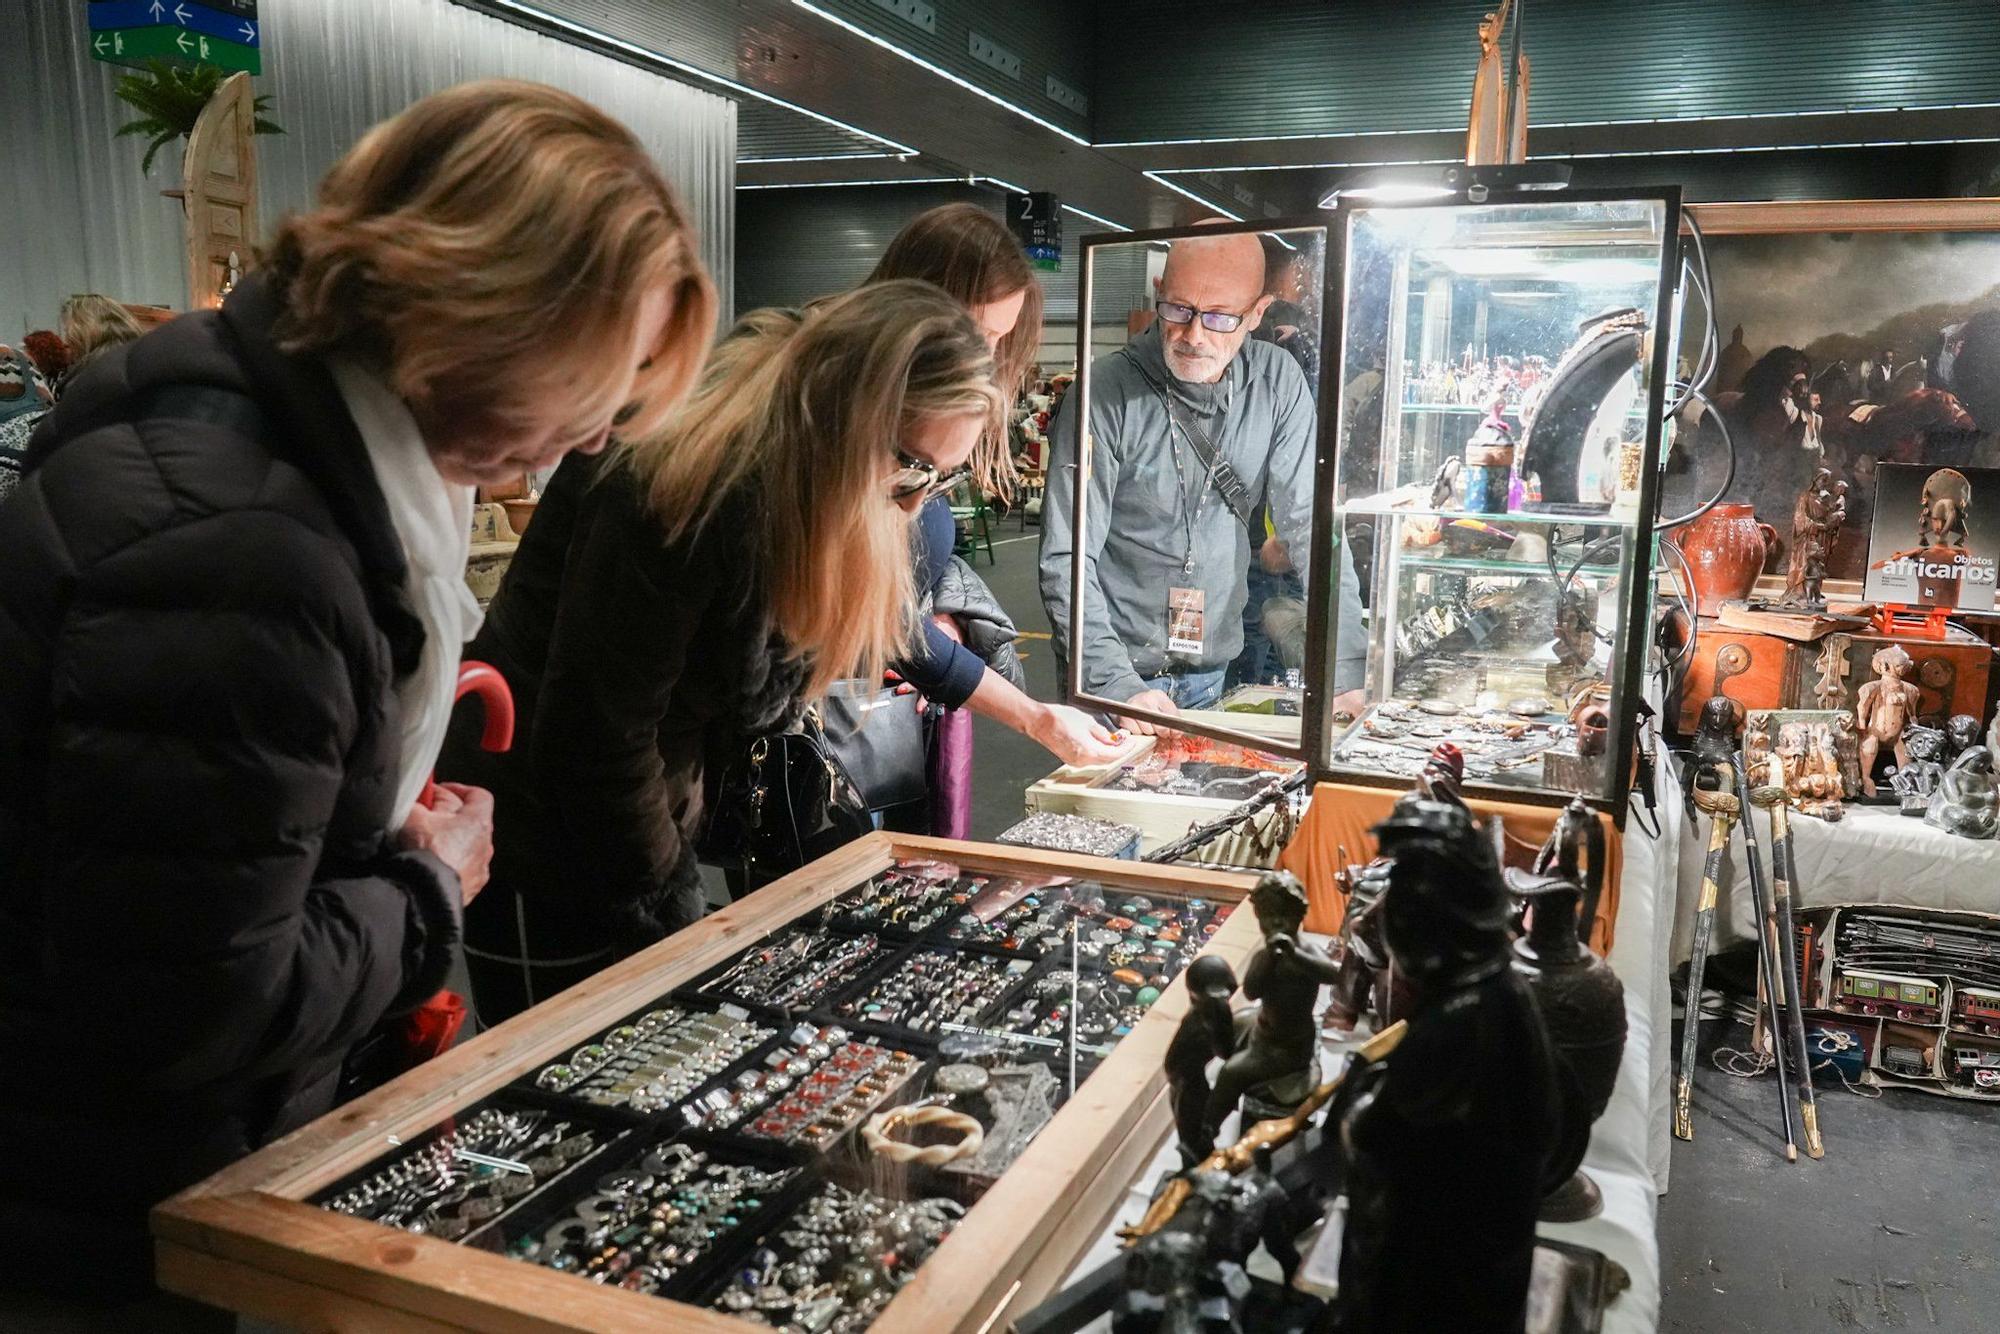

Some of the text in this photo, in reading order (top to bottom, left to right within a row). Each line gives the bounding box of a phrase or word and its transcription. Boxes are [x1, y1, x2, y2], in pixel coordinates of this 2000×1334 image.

[1020, 197, 1034, 220] 2
[1882, 556, 1996, 582] africanos
[1953, 554, 1993, 567] Objetos
